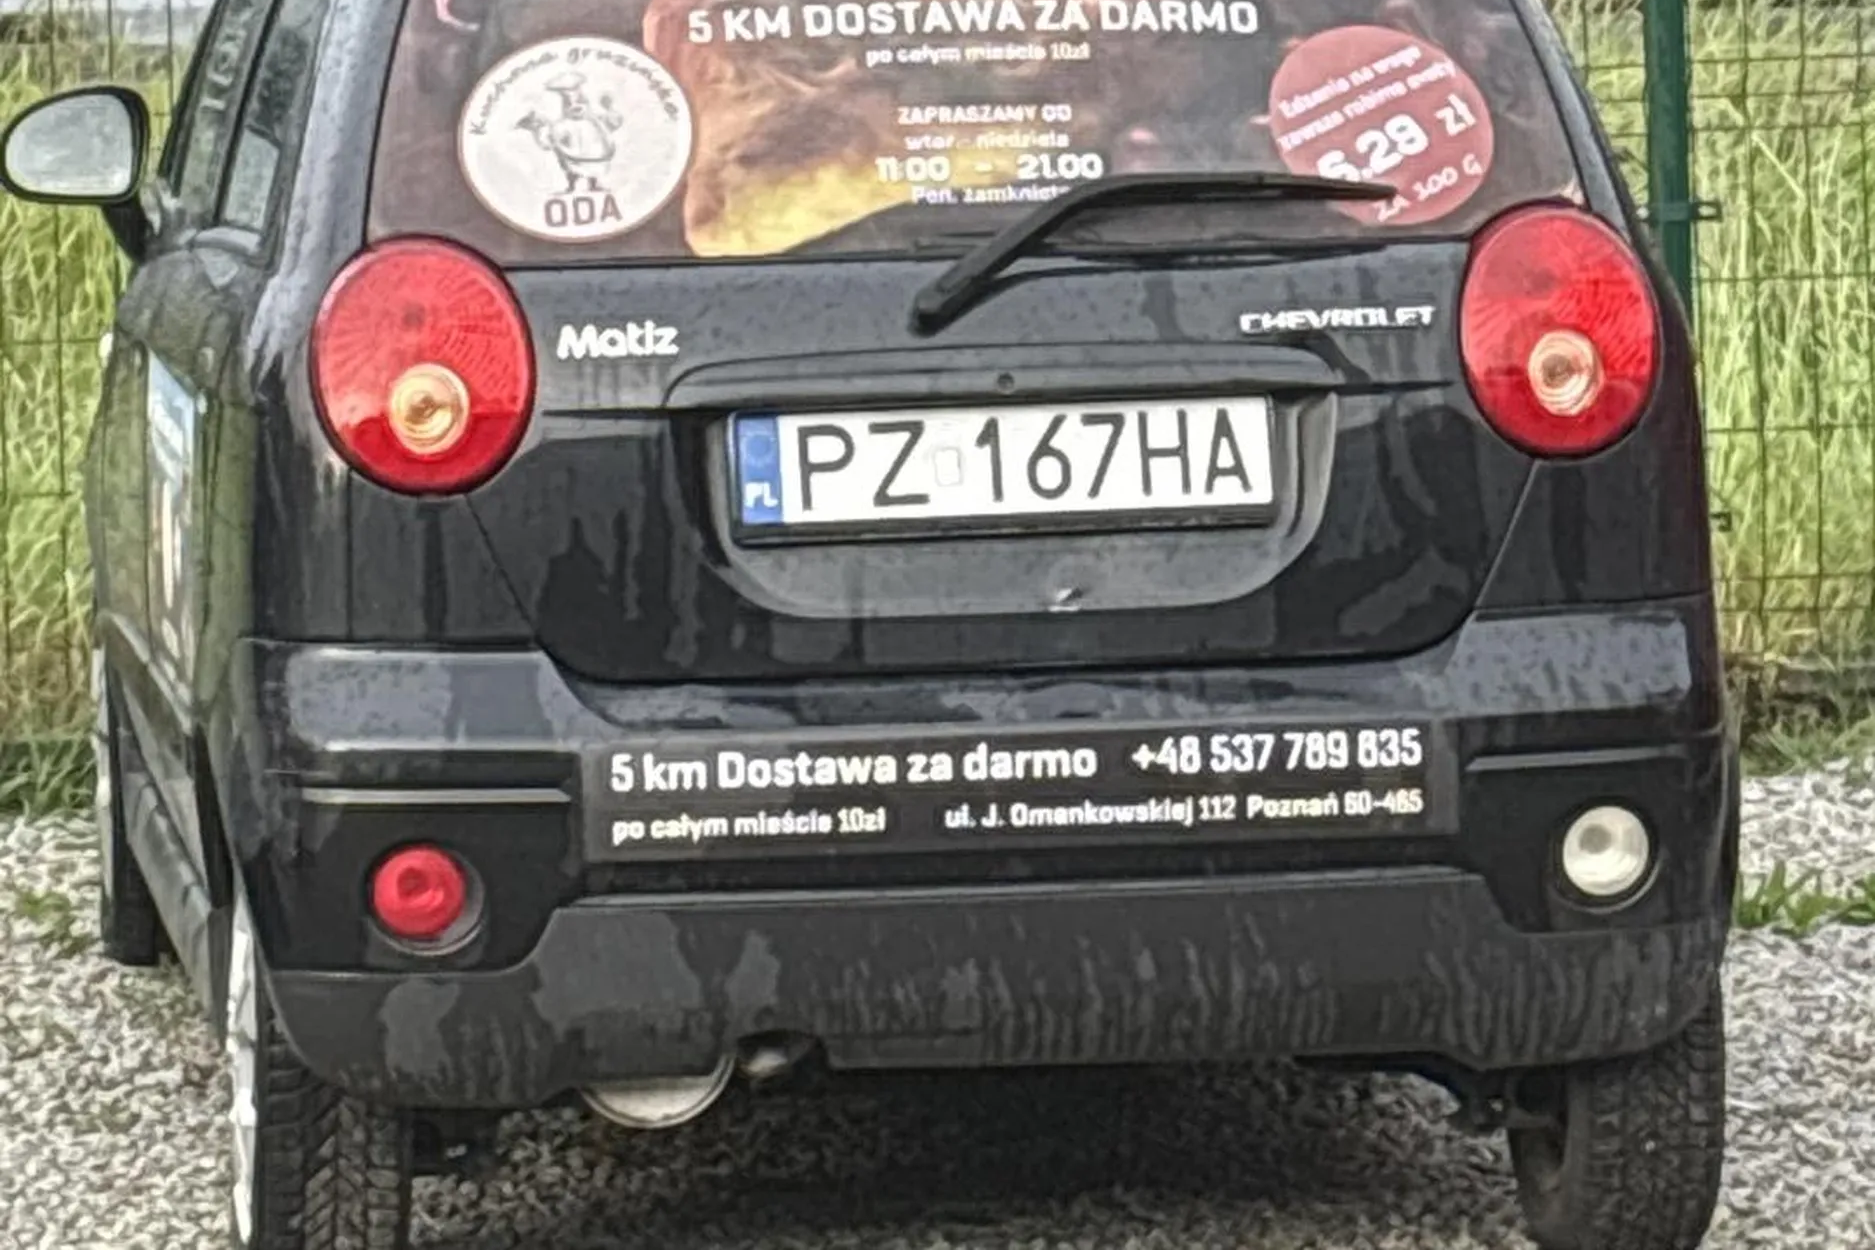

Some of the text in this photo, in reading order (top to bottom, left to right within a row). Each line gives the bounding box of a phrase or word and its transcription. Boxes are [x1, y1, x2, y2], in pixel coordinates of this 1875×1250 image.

[688, 10, 713, 43] 5
[724, 6, 791, 41] KM
[1100, 0, 1259, 34] DARMO
[866, 49, 893, 68] po
[897, 105, 1038, 125] ZAPRASZAMY
[1015, 152, 1104, 180] 21.00
[544, 194, 623, 227] ODA
[1239, 305, 1437, 333] CHEVROLET
[556, 319, 680, 360] Matiz
[797, 406, 1253, 511] PZ 167HA
[744, 481, 778, 507] PL
[610, 753, 634, 792] 5
[643, 752, 707, 790] km
[717, 750, 897, 789] Dostawa
[906, 751, 953, 782] za
[963, 742, 1098, 780] darmo
[1131, 736, 1200, 773] +48
[1209, 733, 1275, 771] 537
[611, 819, 645, 846] po
[1198, 797, 1237, 821] 112
[1246, 792, 1339, 820] Poznań
